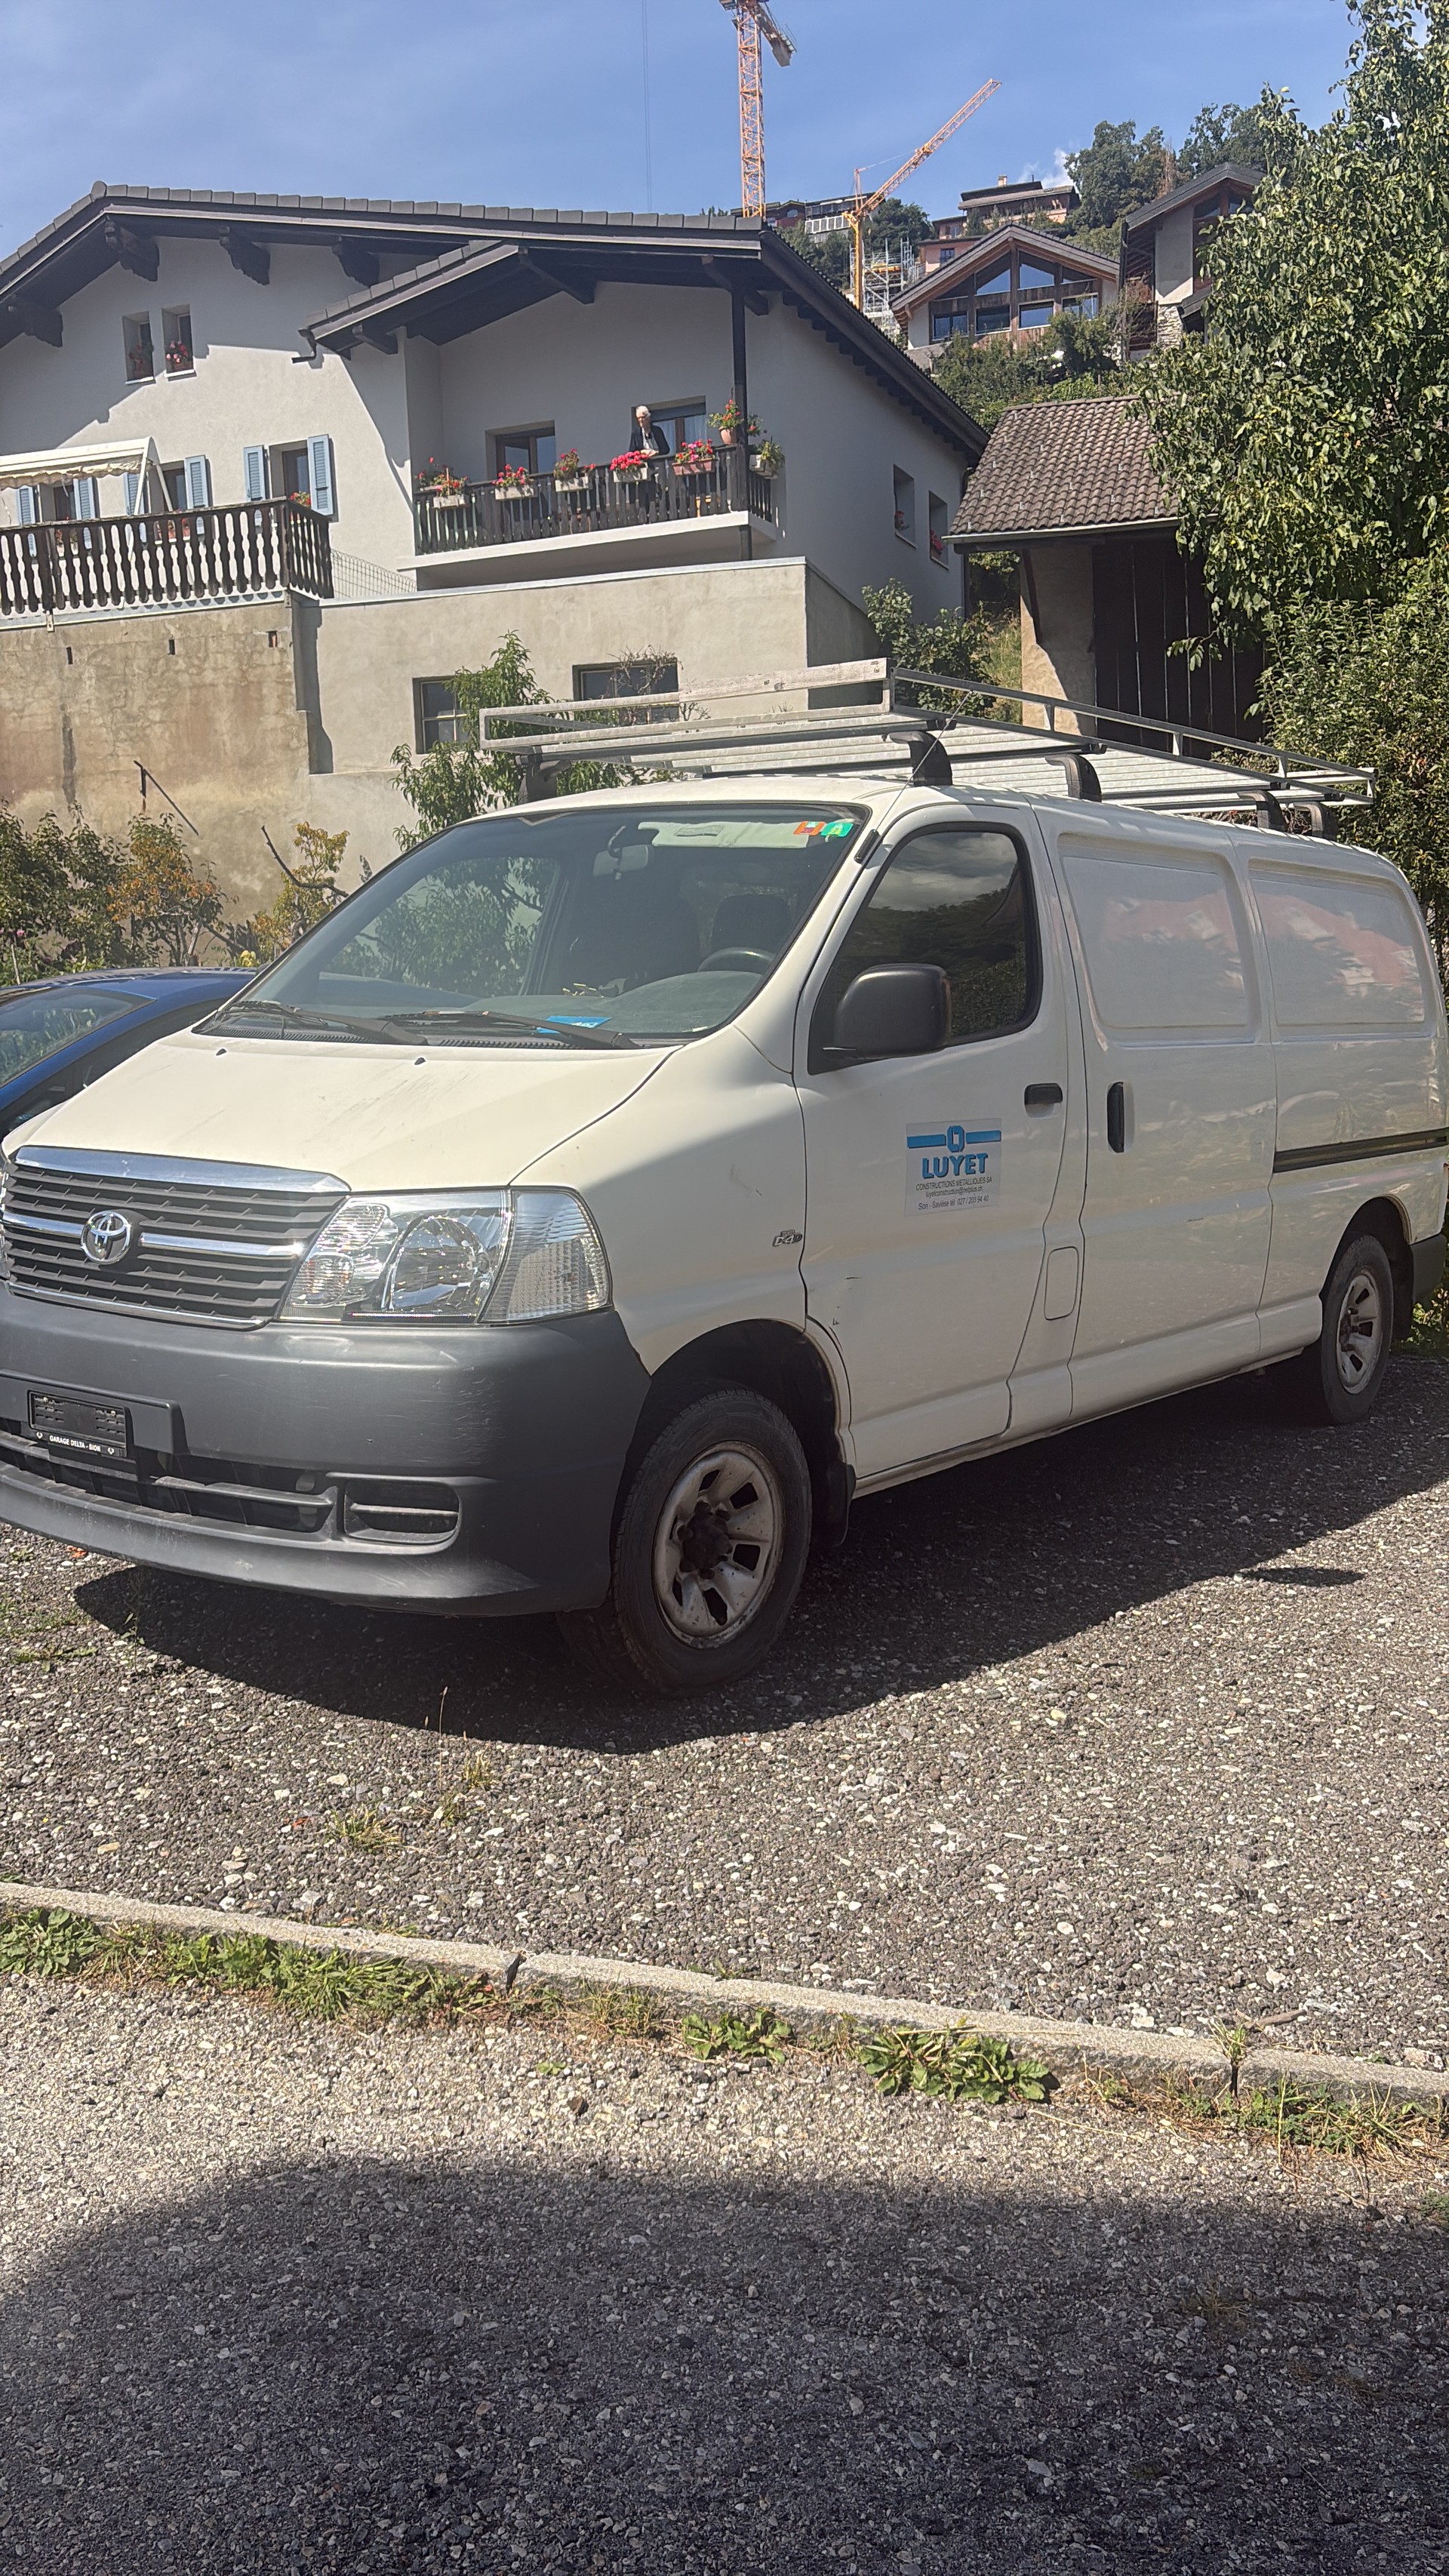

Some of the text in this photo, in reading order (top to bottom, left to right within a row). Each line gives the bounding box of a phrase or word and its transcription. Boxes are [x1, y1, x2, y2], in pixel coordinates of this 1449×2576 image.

[921, 1153, 988, 1179] LUYET
[915, 1180, 955, 1191] CONSTRUCTIONS
[955, 1177, 986, 1186] METALLIQUES
[957, 1197, 965, 1205] 027
[968, 1196, 977, 1204] 203
[977, 1195, 983, 1203] 94
[49, 1435, 69, 1445] GARAGE
[70, 1439, 85, 1448] DELTA
[88, 1443, 101, 1452] SION
